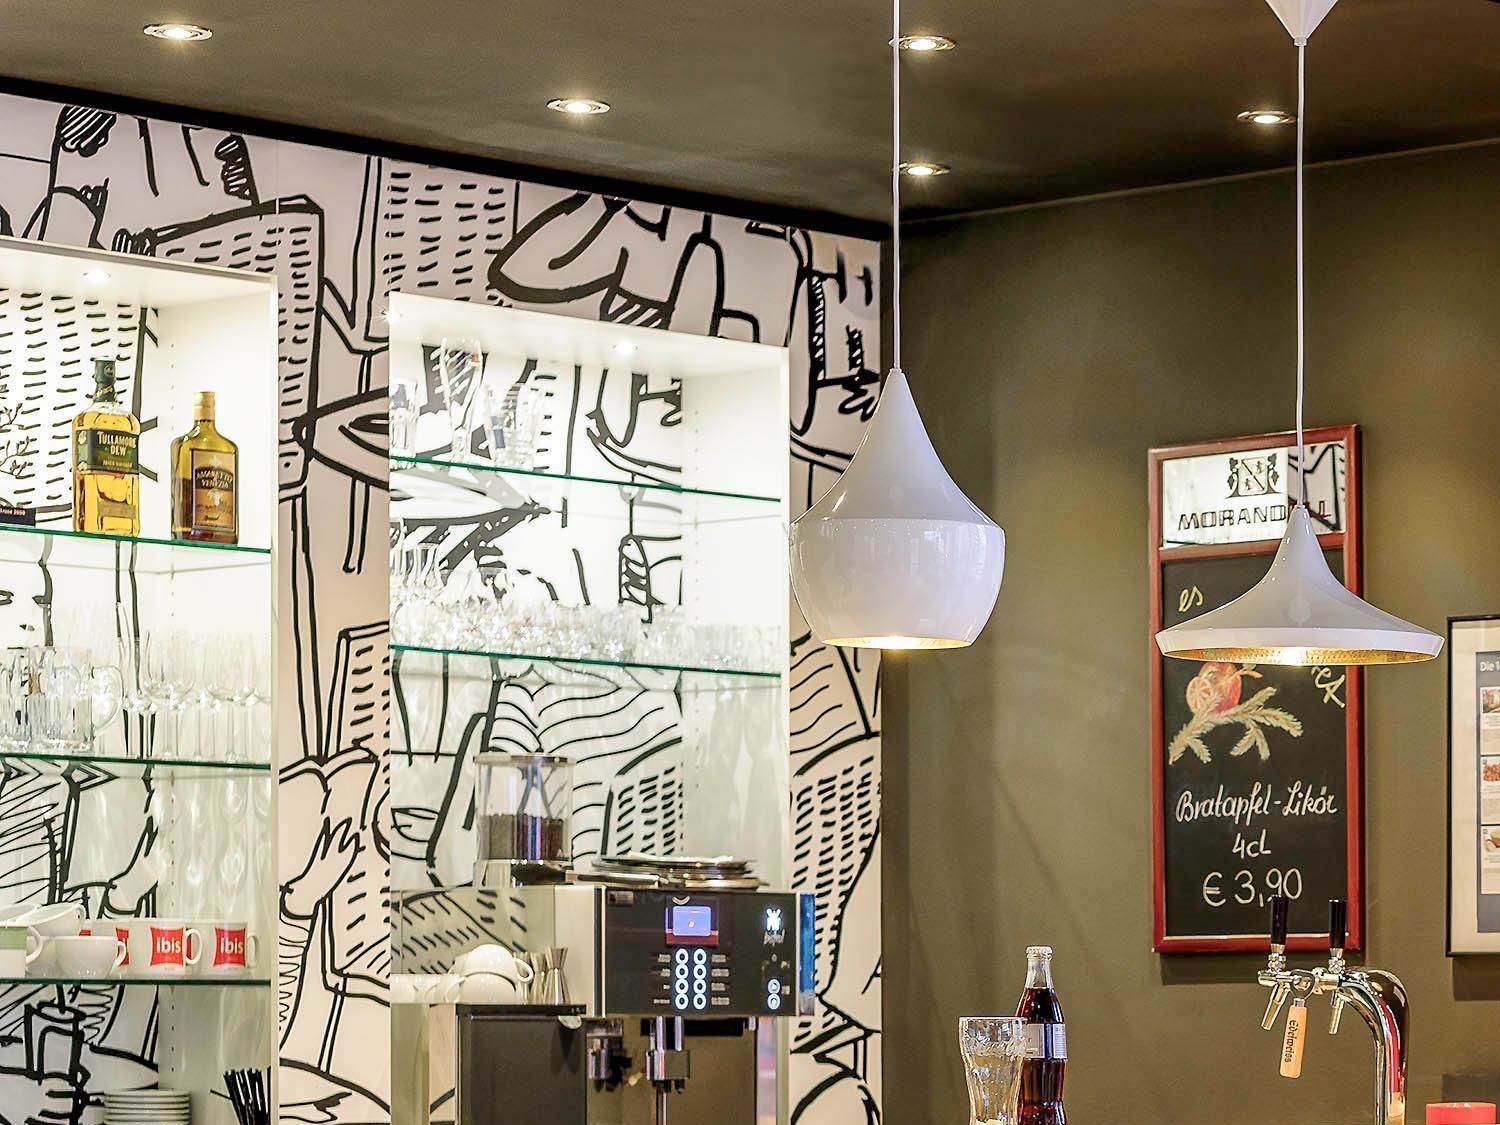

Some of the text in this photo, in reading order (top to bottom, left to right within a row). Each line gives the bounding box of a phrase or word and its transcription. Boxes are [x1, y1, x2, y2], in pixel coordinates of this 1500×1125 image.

[1480, 661, 1495, 672] Die
[156, 937, 181, 954] ibis
[220, 937, 244, 955] ibis
